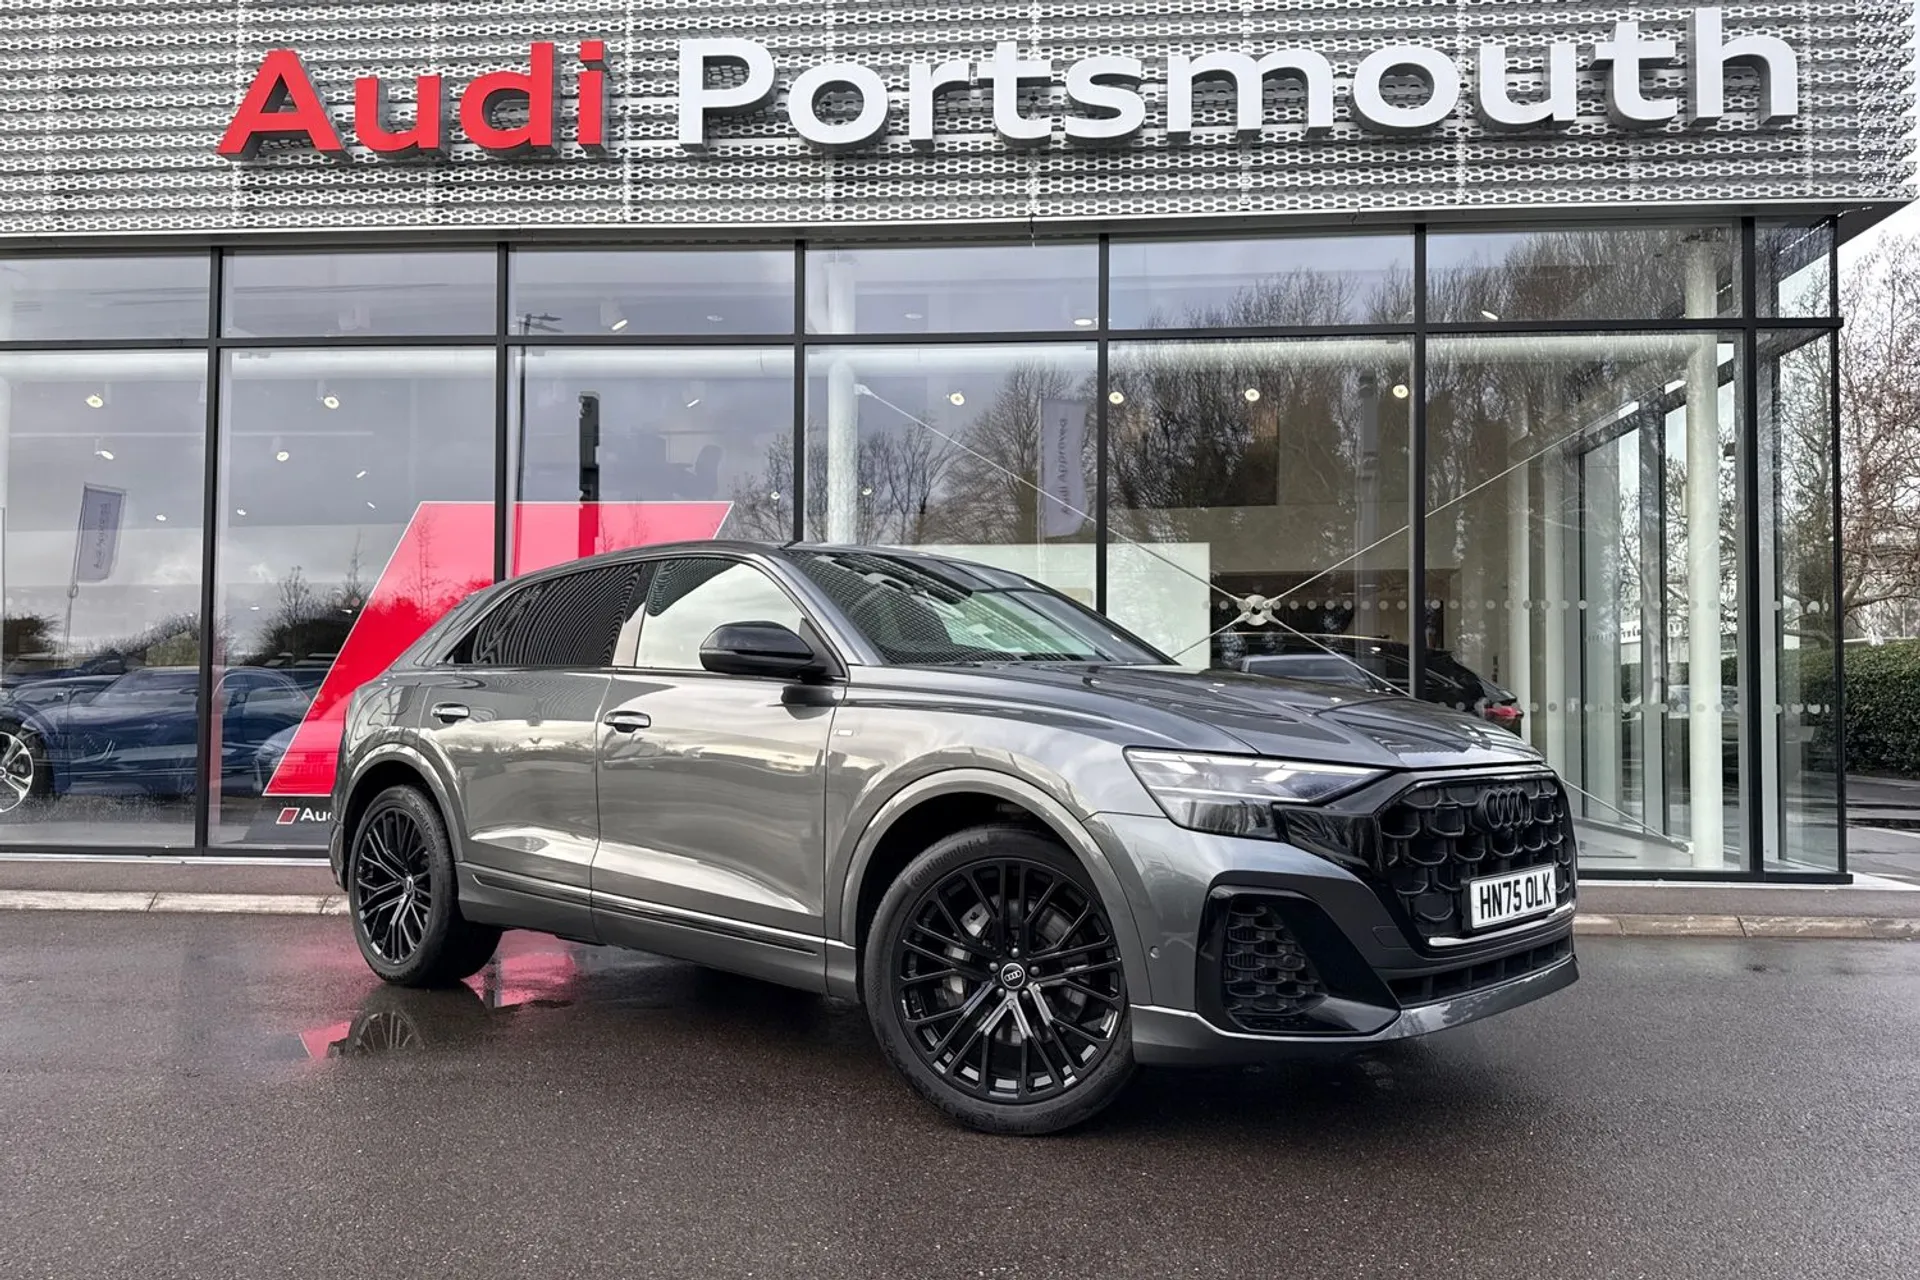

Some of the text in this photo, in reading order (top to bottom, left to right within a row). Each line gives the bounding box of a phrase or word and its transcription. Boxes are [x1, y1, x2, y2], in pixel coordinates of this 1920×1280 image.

[217, 7, 1799, 157] Audi Portsmouth
[1479, 872, 1552, 920] HN75 OLK
